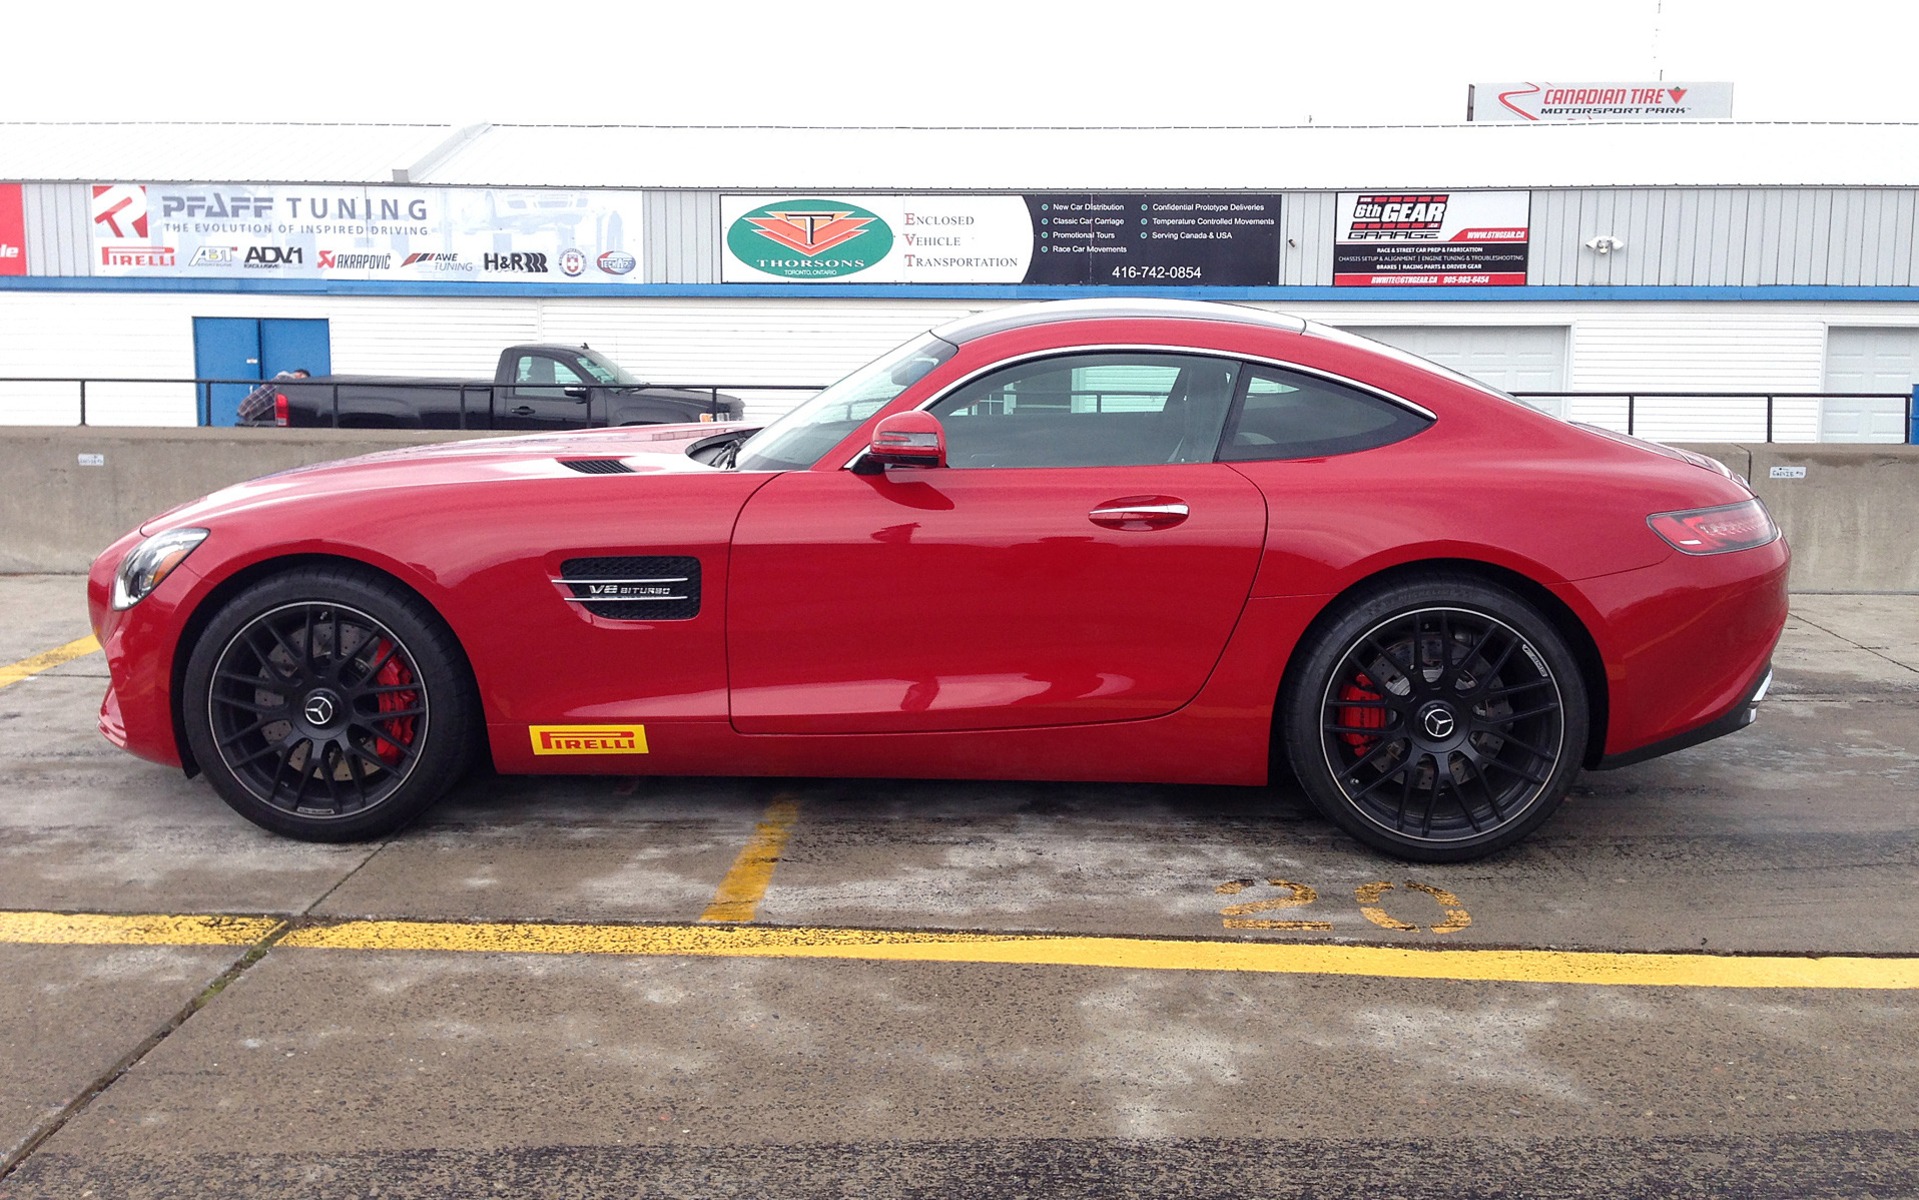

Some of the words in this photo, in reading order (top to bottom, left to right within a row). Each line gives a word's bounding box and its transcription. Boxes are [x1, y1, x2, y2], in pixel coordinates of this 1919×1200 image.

[1543, 88, 1627, 104] CANADIAN
[1631, 88, 1665, 104] TIRE
[162, 193, 274, 218] PFAFF
[286, 197, 427, 221] TUNING
[1084, 203, 1124, 211] Distribution
[1152, 203, 1194, 211] Confidential
[1196, 203, 1229, 212] Prototype
[1230, 203, 1264, 211] Deliveries
[1354, 203, 1382, 218] 6th
[1381, 203, 1446, 222] GEAR
[1094, 218, 1124, 226] Carriage
[1152, 218, 1196, 227] Temperature
[164, 223, 188, 233] THE
[195, 223, 272, 234] EVOLUTION
[278, 224, 294, 234] OF
[301, 225, 363, 235] INSPIRED
[371, 225, 428, 235] DRIVING
[1152, 232, 1178, 240] Serving
[1348, 231, 1440, 240] GARAGE
[0, 243, 19, 258] le
[101, 246, 175, 266] PIRELLI
[188, 246, 232, 267] ABT
[435, 253, 458, 262] AWE
[434, 262, 473, 272] TUNING
[756, 259, 865, 268] THORSONS
[1112, 266, 1202, 279] 416-742-0854
[589, 584, 618, 594] V8
[620, 587, 671, 595] BITURBO
[540, 731, 636, 750] PIRELLI
[1215, 878, 1472, 934] 20
